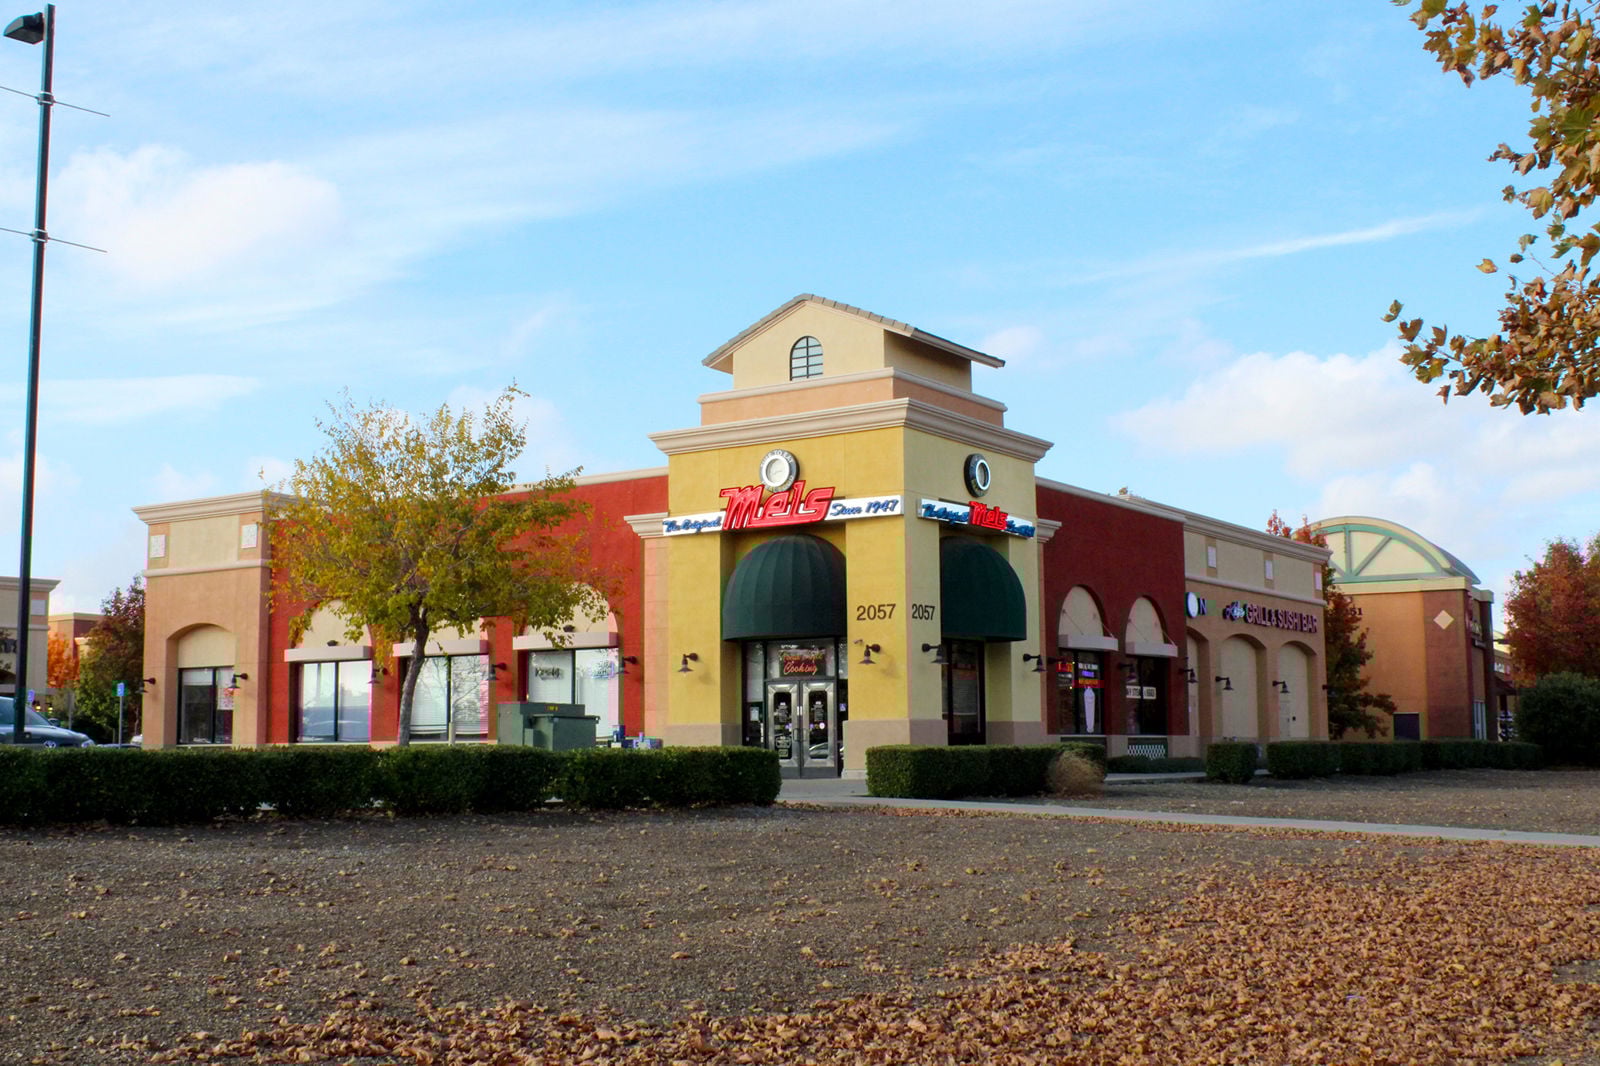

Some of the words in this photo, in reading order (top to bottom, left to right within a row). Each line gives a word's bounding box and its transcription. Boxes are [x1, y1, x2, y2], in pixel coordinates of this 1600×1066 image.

[719, 480, 836, 531] Mels
[830, 502, 862, 517] Since
[865, 499, 900, 514] 1947
[968, 501, 1008, 530] Mels
[856, 603, 896, 621] 2057
[911, 603, 936, 621] 2057
[1244, 603, 1271, 627] GRILL
[1278, 608, 1303, 631] SUSHI
[1302, 613, 1318, 633] BAR
[783, 661, 817, 676] Cooking
